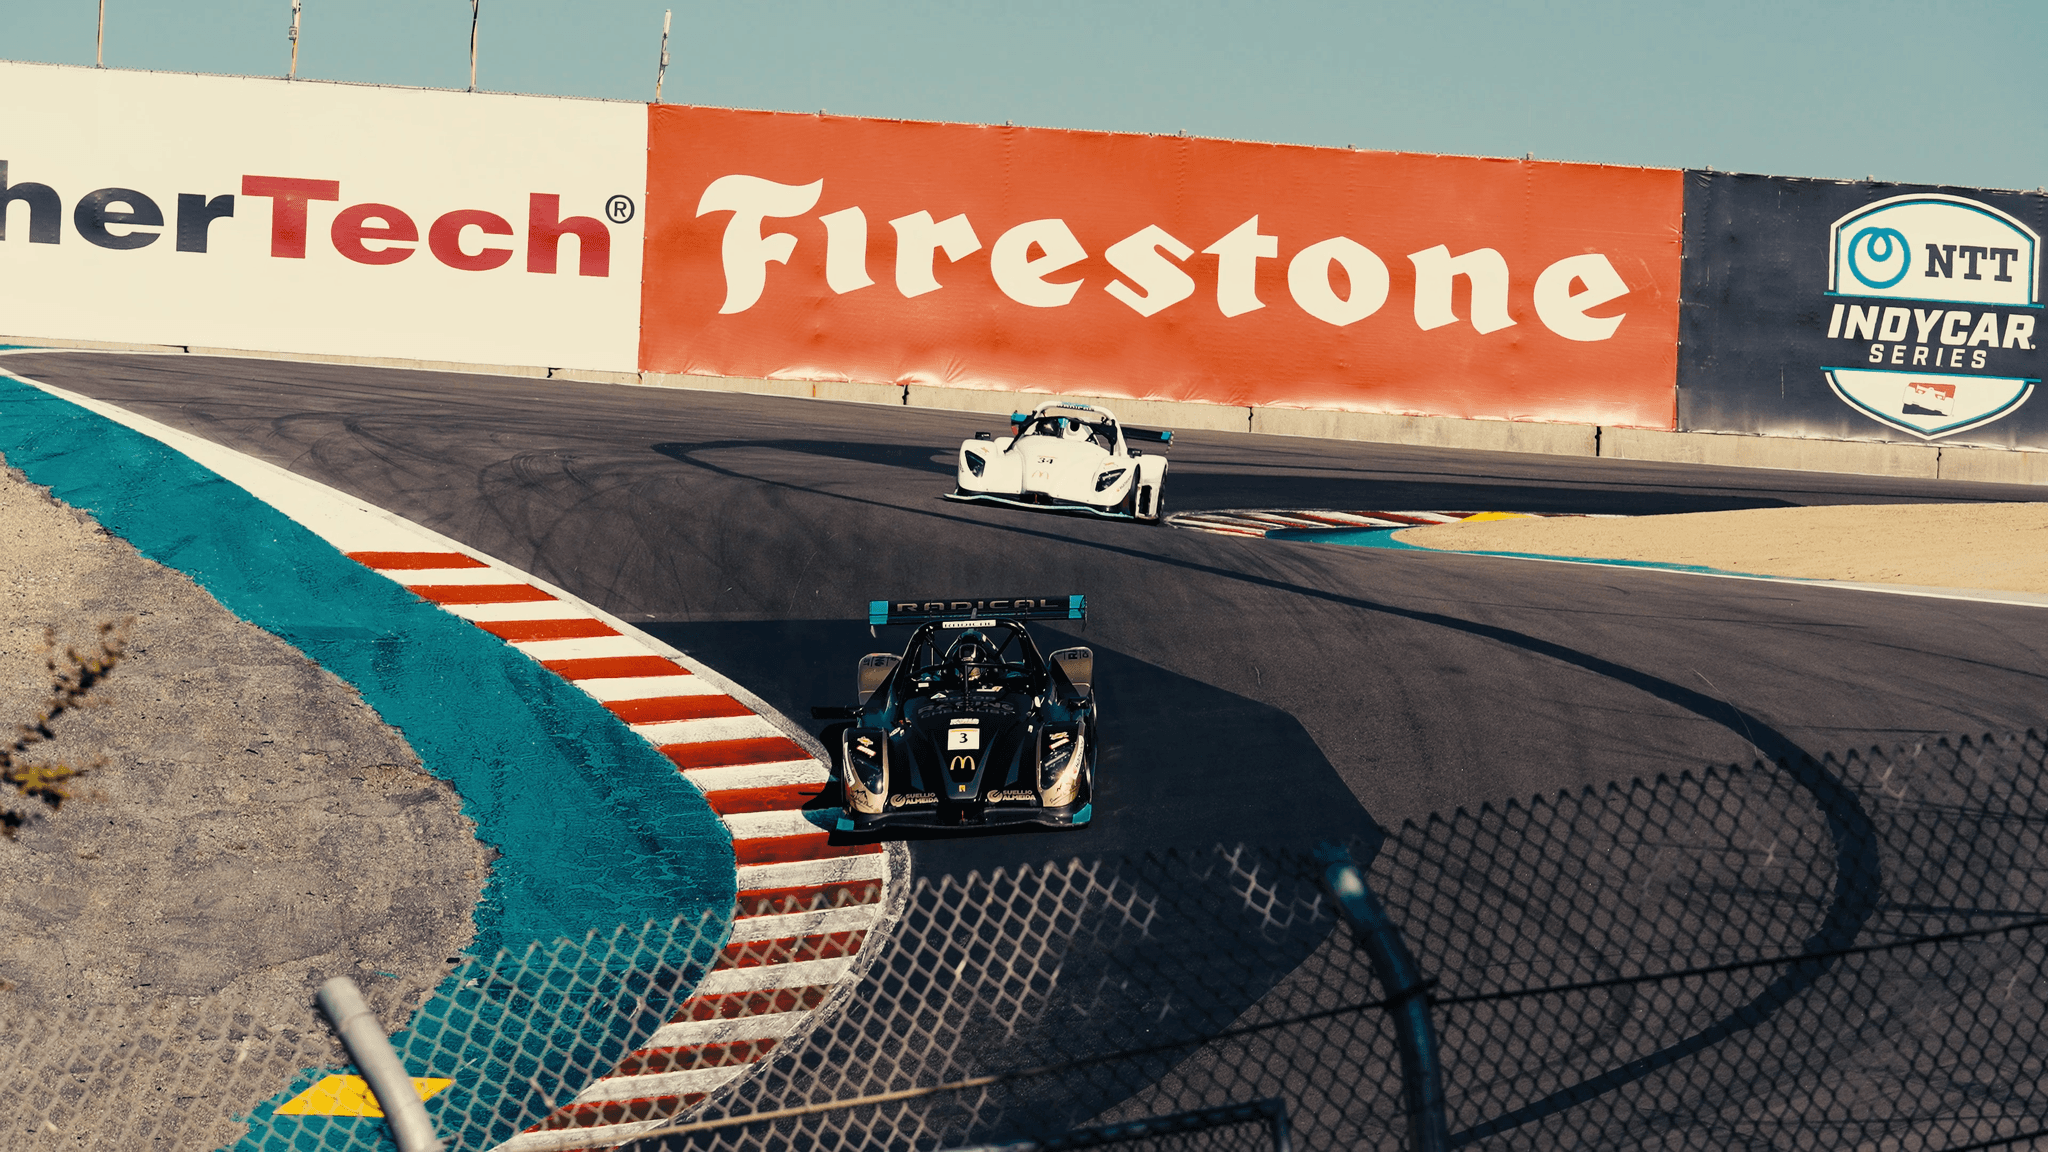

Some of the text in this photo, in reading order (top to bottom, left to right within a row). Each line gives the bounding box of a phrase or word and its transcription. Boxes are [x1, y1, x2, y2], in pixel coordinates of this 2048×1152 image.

[696, 174, 1630, 342] Firestone
[1925, 243, 2019, 283] NTT
[1868, 343, 1988, 369] SERIES
[1037, 457, 1054, 465] 34
[896, 599, 1059, 612] RADICAL
[959, 732, 968, 744] 3
[905, 797, 939, 805] ALMEIDA
